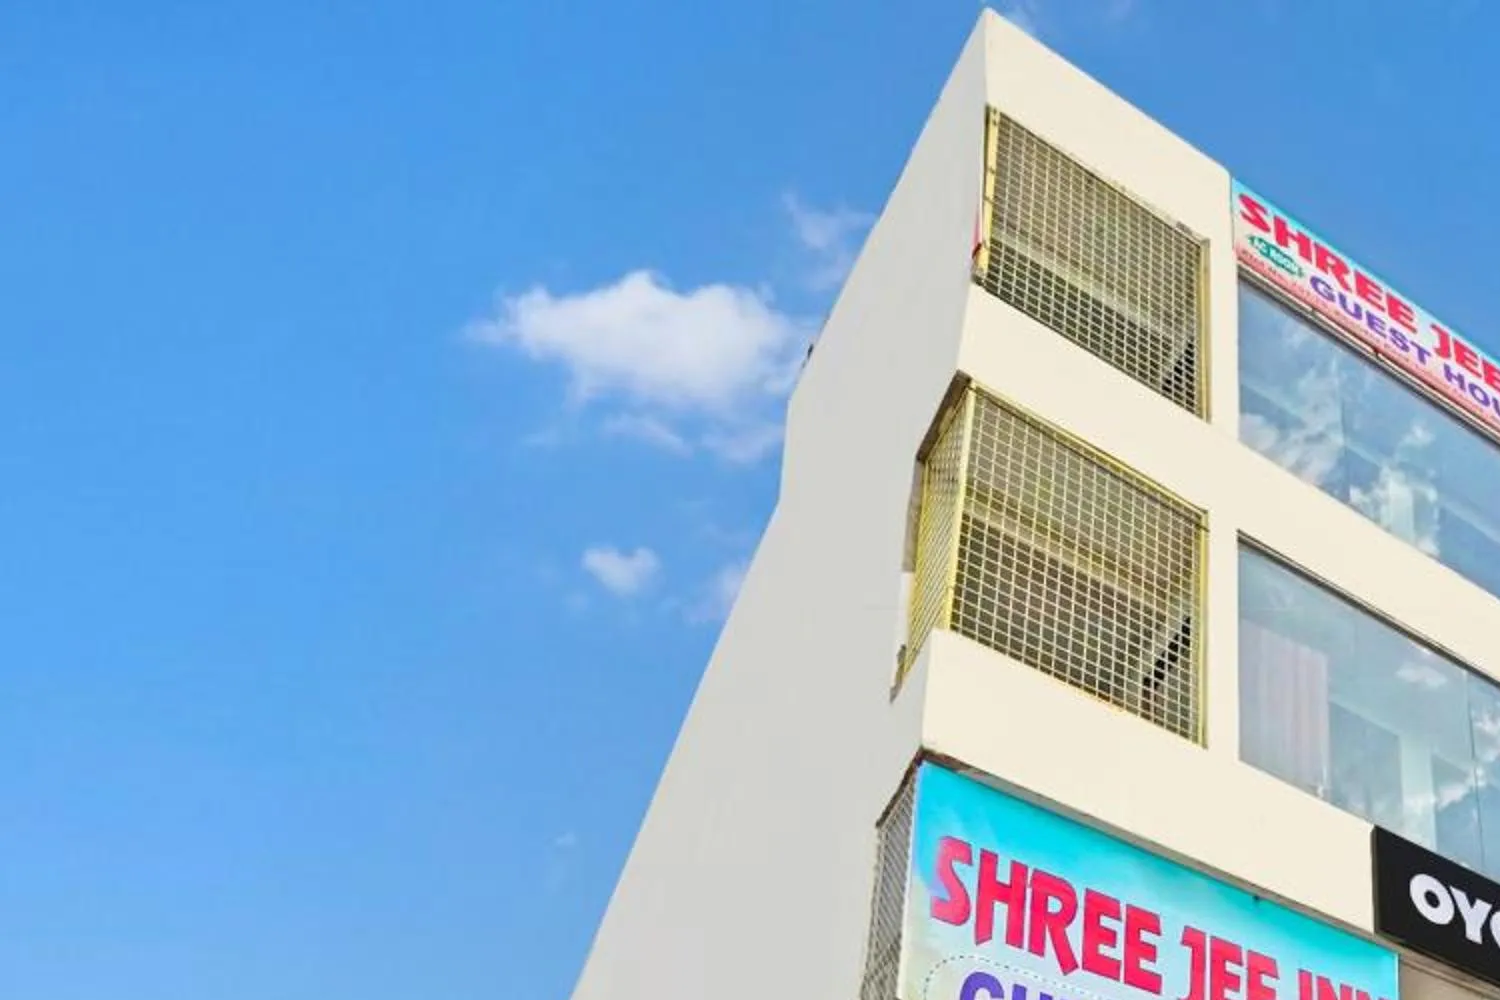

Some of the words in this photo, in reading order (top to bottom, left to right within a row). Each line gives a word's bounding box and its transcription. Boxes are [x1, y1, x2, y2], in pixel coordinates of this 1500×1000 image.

[1238, 193, 1418, 334] SHREE
[1309, 275, 1431, 365] GUEST
[930, 835, 1163, 996] SHREE
